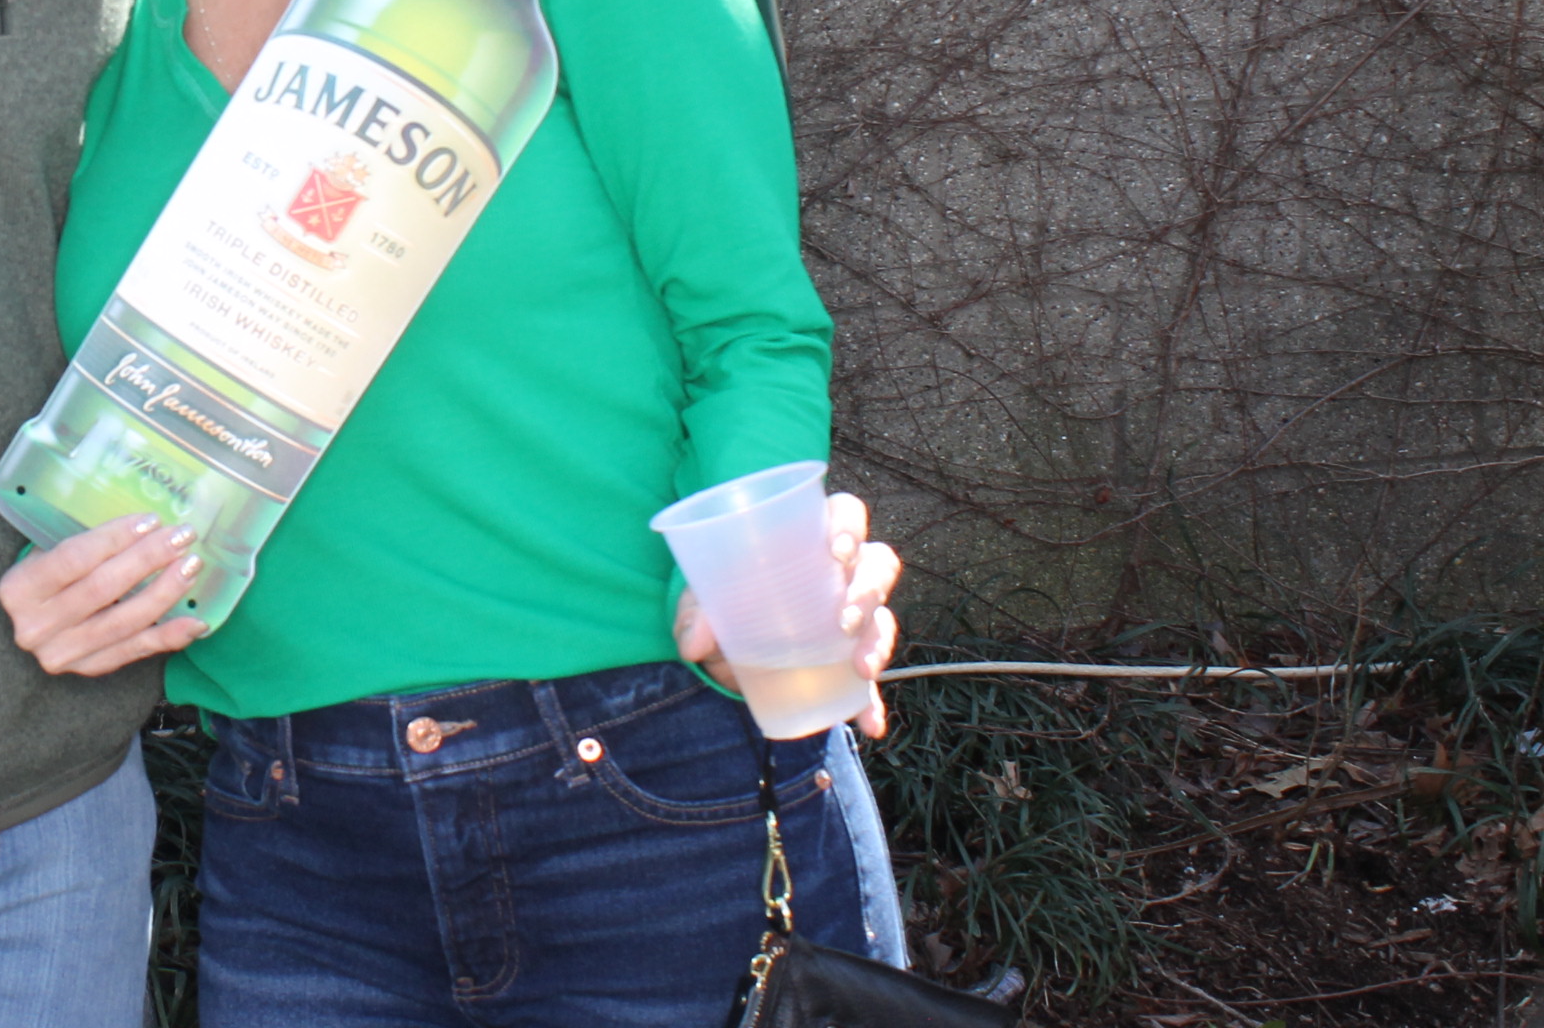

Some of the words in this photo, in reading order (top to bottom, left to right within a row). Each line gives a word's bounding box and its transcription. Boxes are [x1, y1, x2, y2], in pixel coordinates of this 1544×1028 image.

[254, 60, 476, 217] JAMESON
[368, 230, 406, 260] 1780
[206, 221, 267, 267] TRIPLE
[268, 262, 359, 324] DISTILLED
[207, 274, 256, 308] JAMESON
[183, 280, 232, 317] IRISH
[235, 312, 316, 367] WHISKEY
[254, 287, 303, 321] WHISKEY
[104, 352, 156, 395] John
